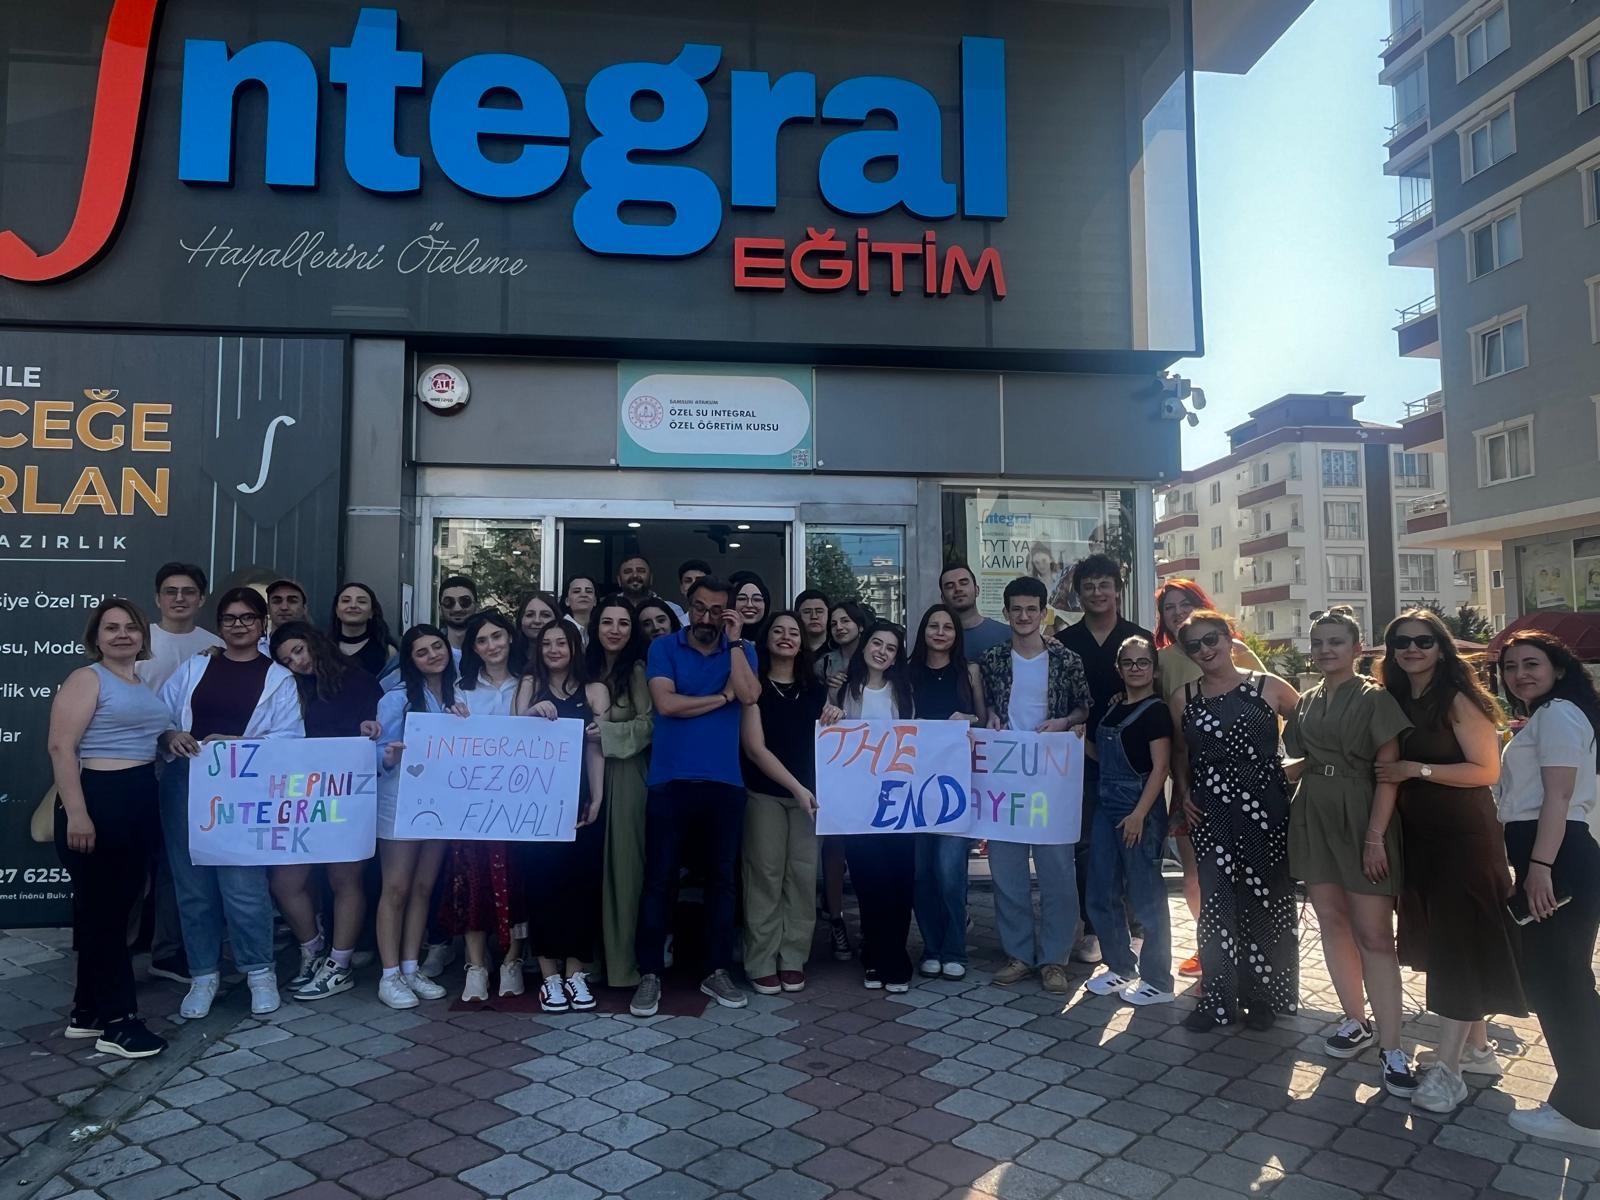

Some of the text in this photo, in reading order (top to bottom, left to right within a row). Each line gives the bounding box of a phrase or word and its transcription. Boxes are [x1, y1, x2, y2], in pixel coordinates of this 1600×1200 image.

[180, 222, 528, 287] Hayallerini Öteleme
[732, 227, 1007, 299] EĞİTİM
[669, 407, 693, 417] ÖZEL
[695, 408, 708, 417] SU
[669, 420, 779, 432] ÖZEL ÖĞRETİM KURSU
[982, 539, 1009, 553] TYT
[0, 592, 30, 611] iye
[34, 591, 75, 609] Özel
[0, 643, 28, 656] su,
[29, 687, 51, 698] ve
[208, 741, 261, 779] SİZ
[818, 722, 918, 776] THE
[971, 740, 1070, 776] EZUN
[870, 773, 967, 830] END
[248, 826, 312, 853] TEK
